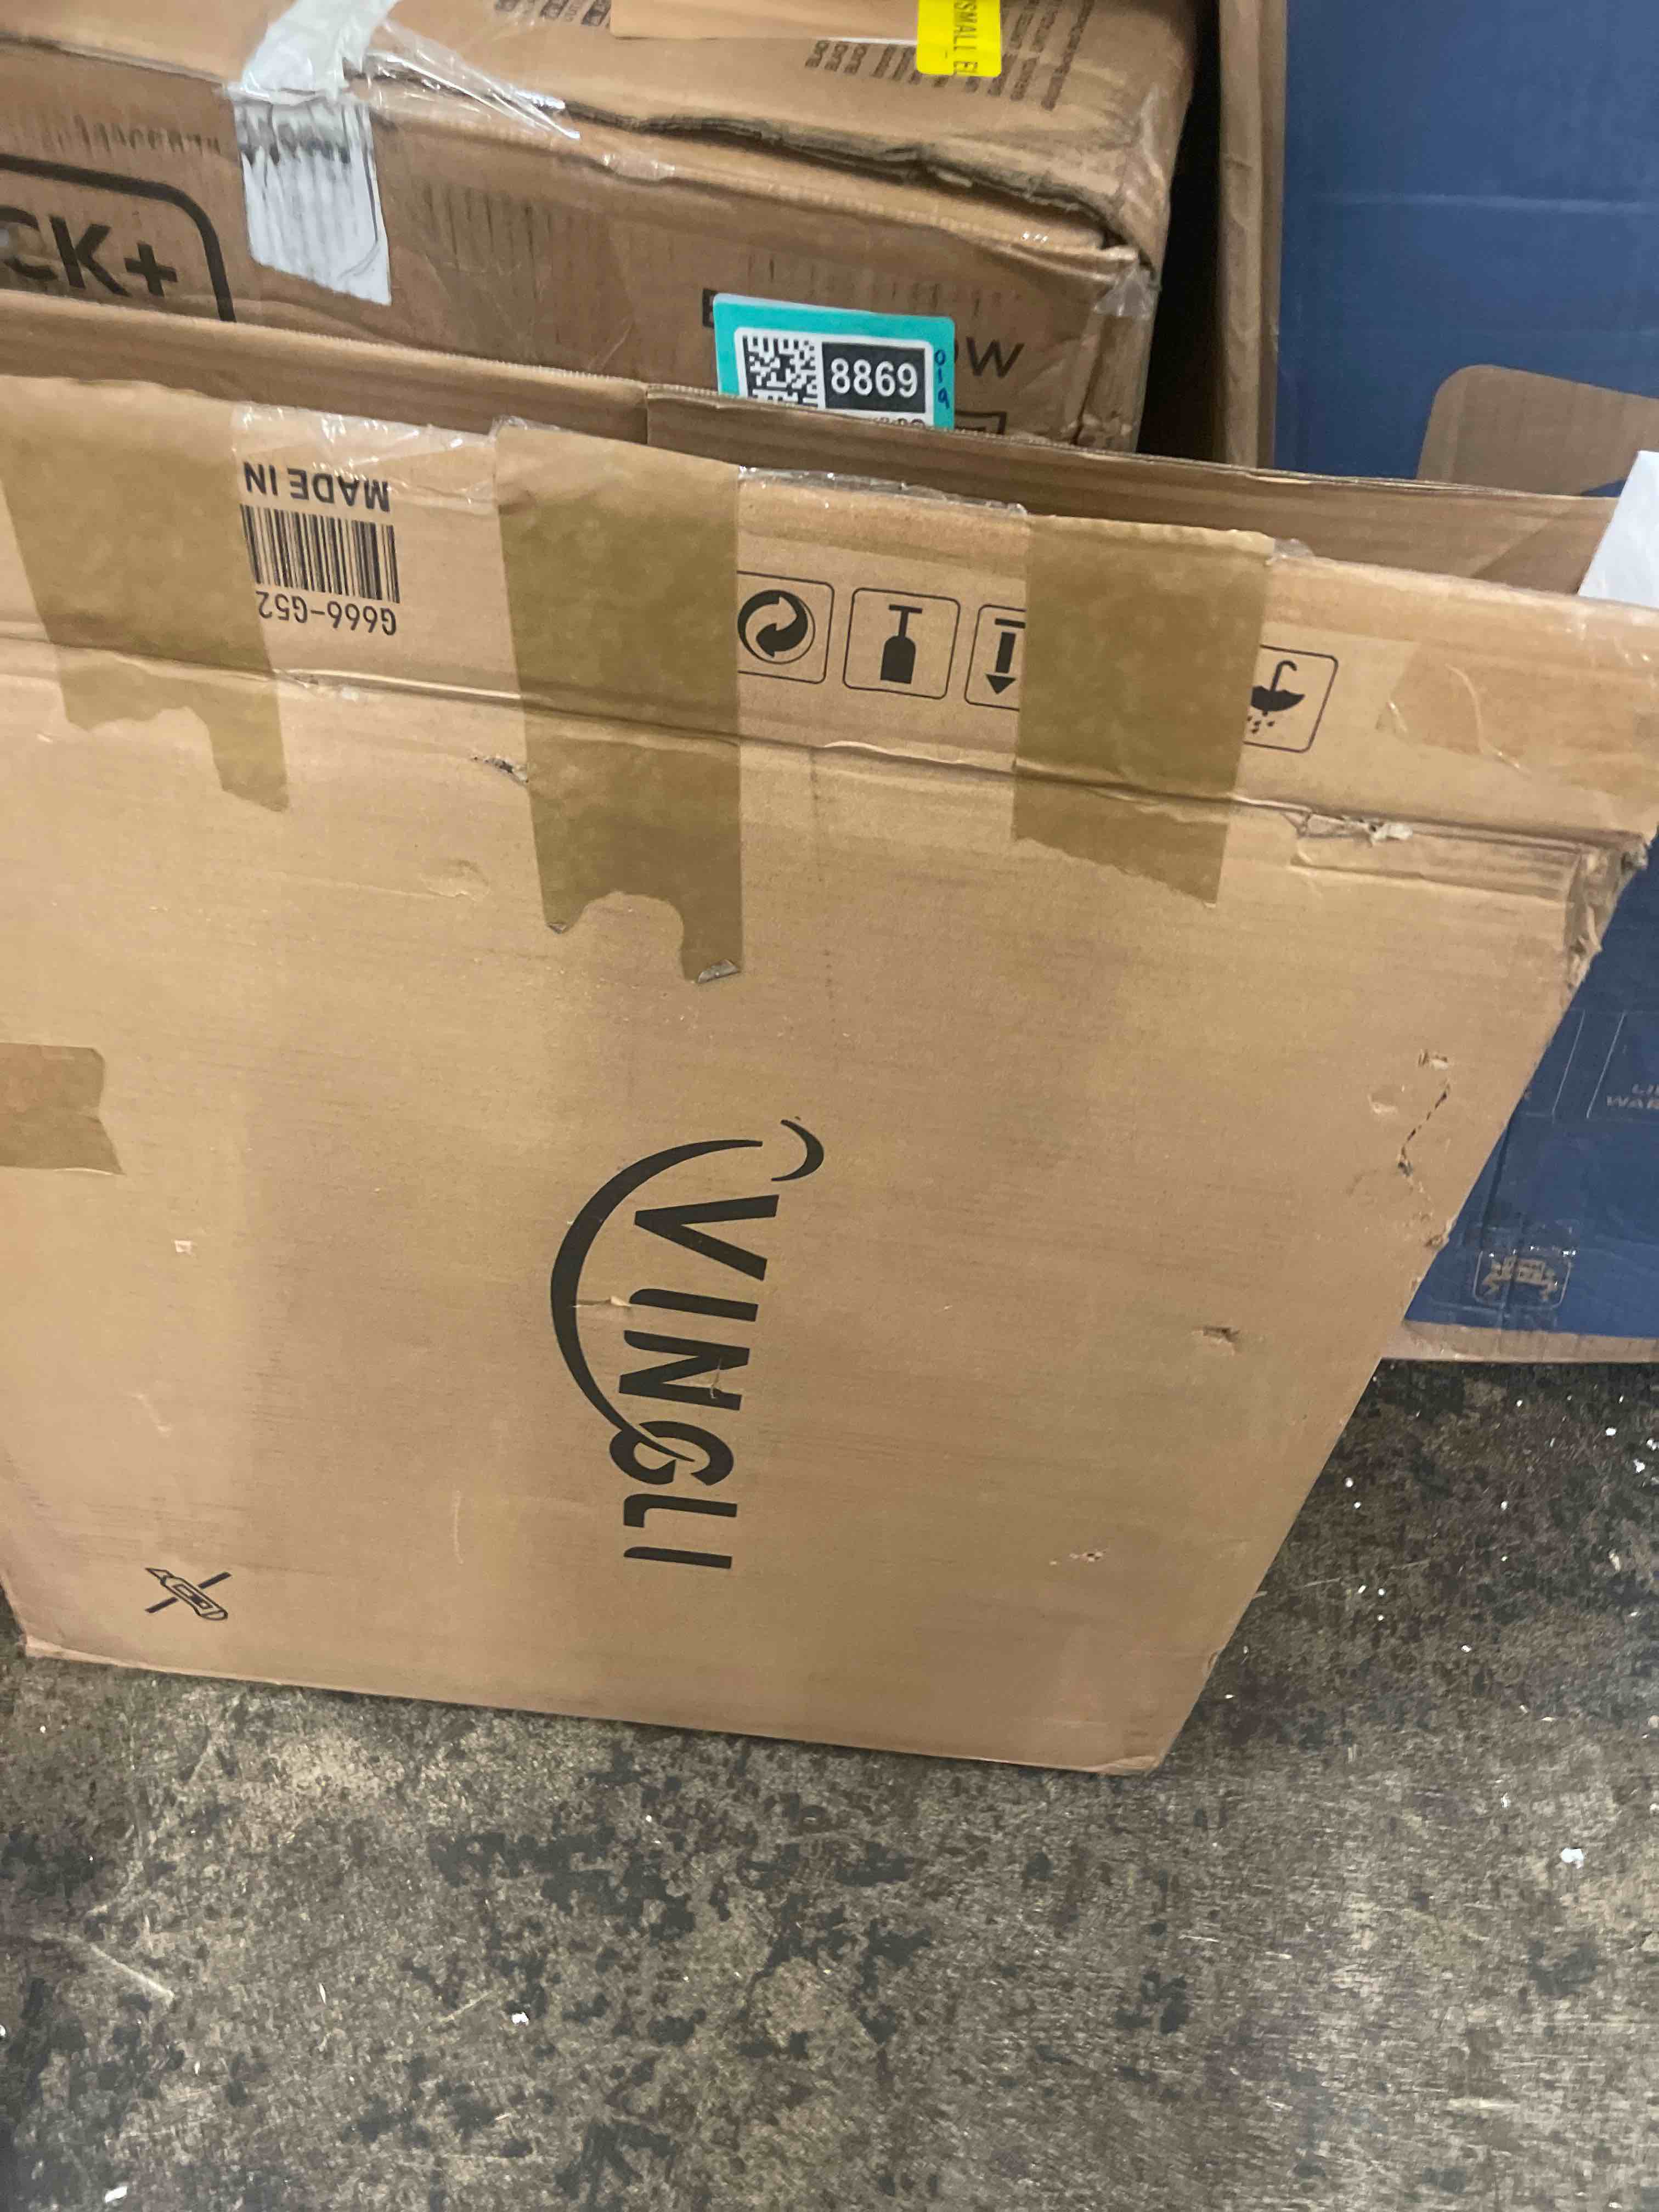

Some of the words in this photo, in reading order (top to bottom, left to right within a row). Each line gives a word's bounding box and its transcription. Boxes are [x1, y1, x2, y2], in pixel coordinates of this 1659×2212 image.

[831, 358, 918, 398] 8869
[955, 336, 1025, 379] W
[242, 461, 279, 496] IN
[287, 467, 390, 512] MADE
[256, 590, 396, 635] G666-G52
[608, 1194, 780, 1570] VINGLI
